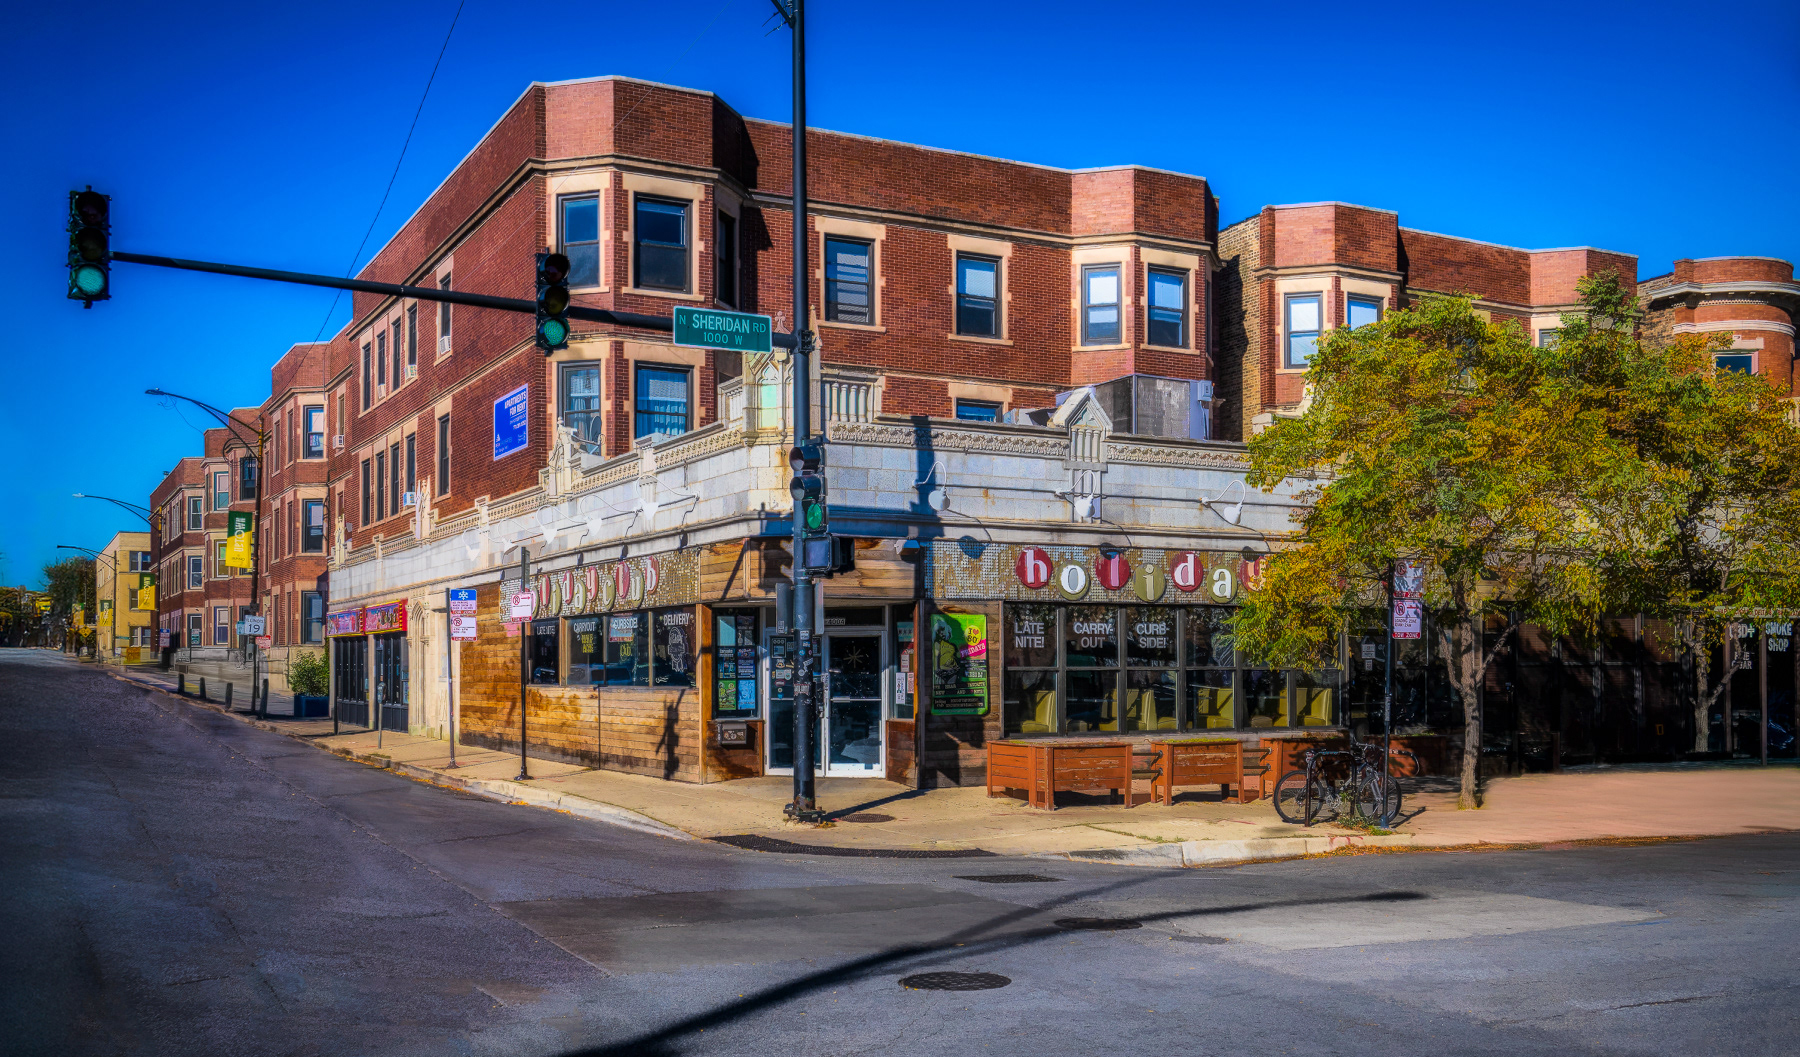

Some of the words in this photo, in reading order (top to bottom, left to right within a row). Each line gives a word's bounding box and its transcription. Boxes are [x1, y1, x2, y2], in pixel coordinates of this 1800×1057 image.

[679, 314, 686, 325] N
[692, 313, 750, 334] SHERIDAN
[752, 322, 767, 333] RD
[703, 332, 729, 344] 1000
[734, 335, 743, 346] W
[603, 555, 656, 606] club
[664, 612, 690, 626] DELIVERY
[248, 624, 260, 633] 19
[1014, 621, 1045, 635] LATE
[1073, 622, 1114, 635] CARRY-
[1136, 622, 1170, 635] CURB-
[1765, 622, 1793, 636] SMOKE
[1015, 636, 1045, 649] NITE!
[1080, 636, 1106, 649] OUT
[1139, 636, 1168, 649] SIDE!
[1768, 638, 1790, 652] SHOP
[960, 642, 986, 658] FRIDAYS
